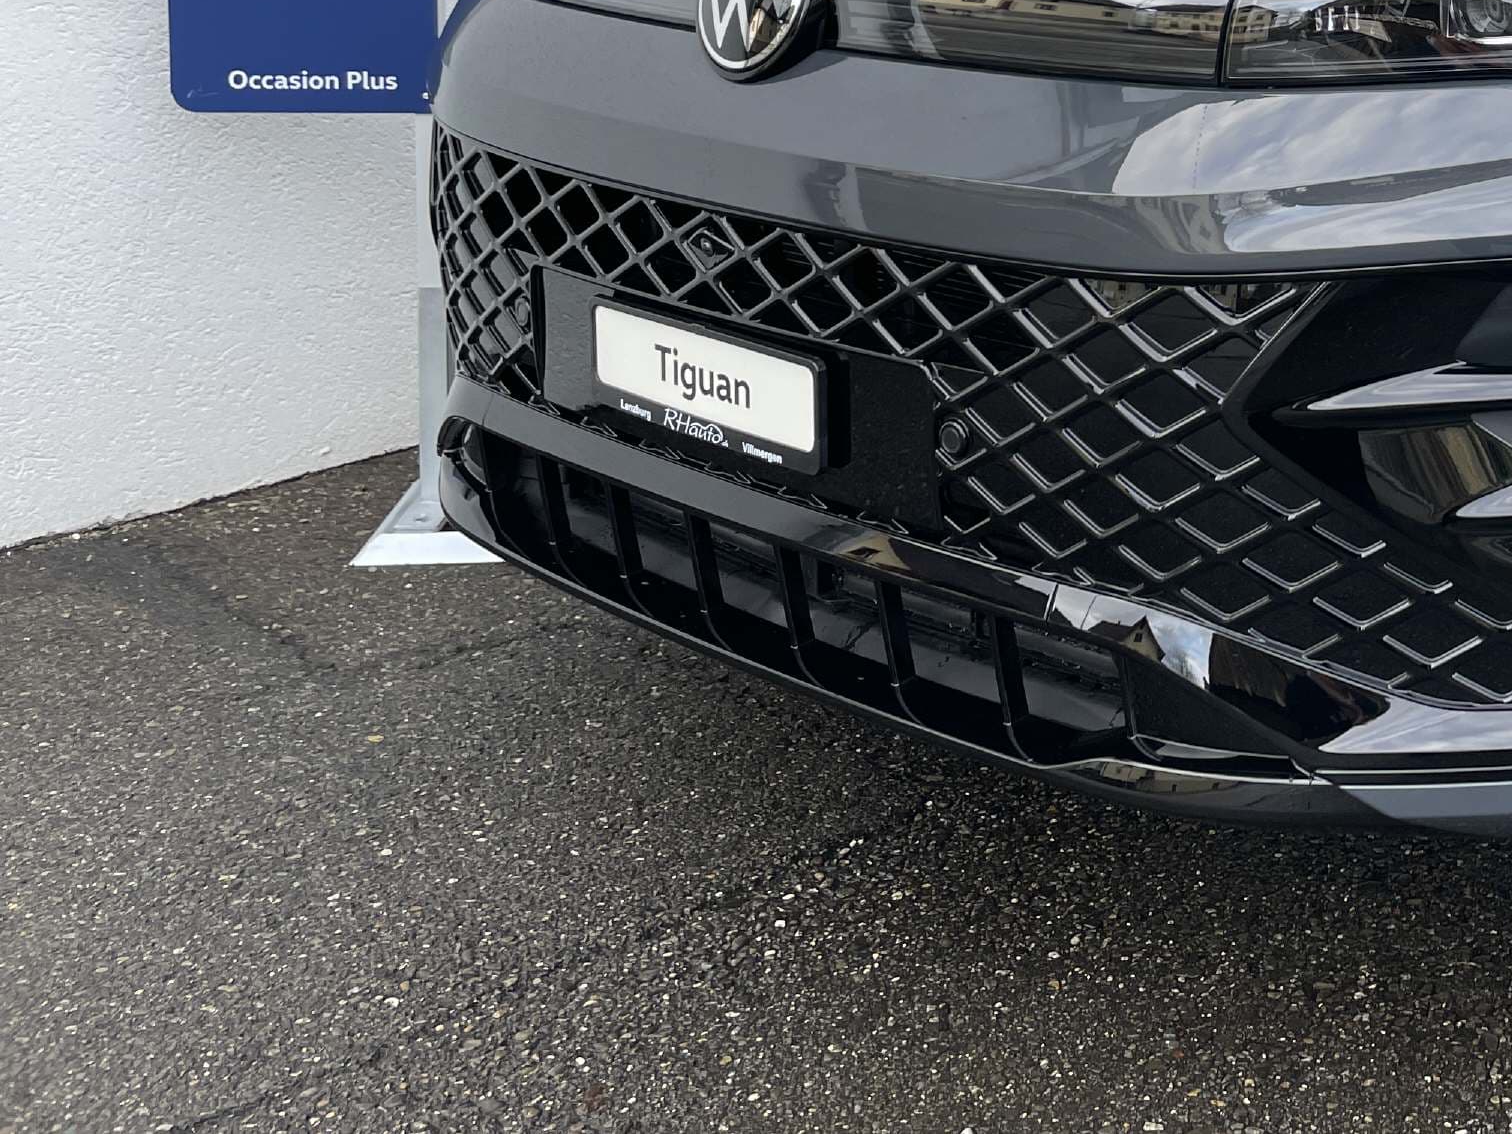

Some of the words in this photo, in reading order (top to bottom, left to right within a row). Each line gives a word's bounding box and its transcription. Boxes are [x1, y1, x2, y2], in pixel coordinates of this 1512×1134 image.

[228, 69, 340, 91] Occasion
[346, 70, 399, 91] Plus
[654, 343, 751, 409] Tiguan
